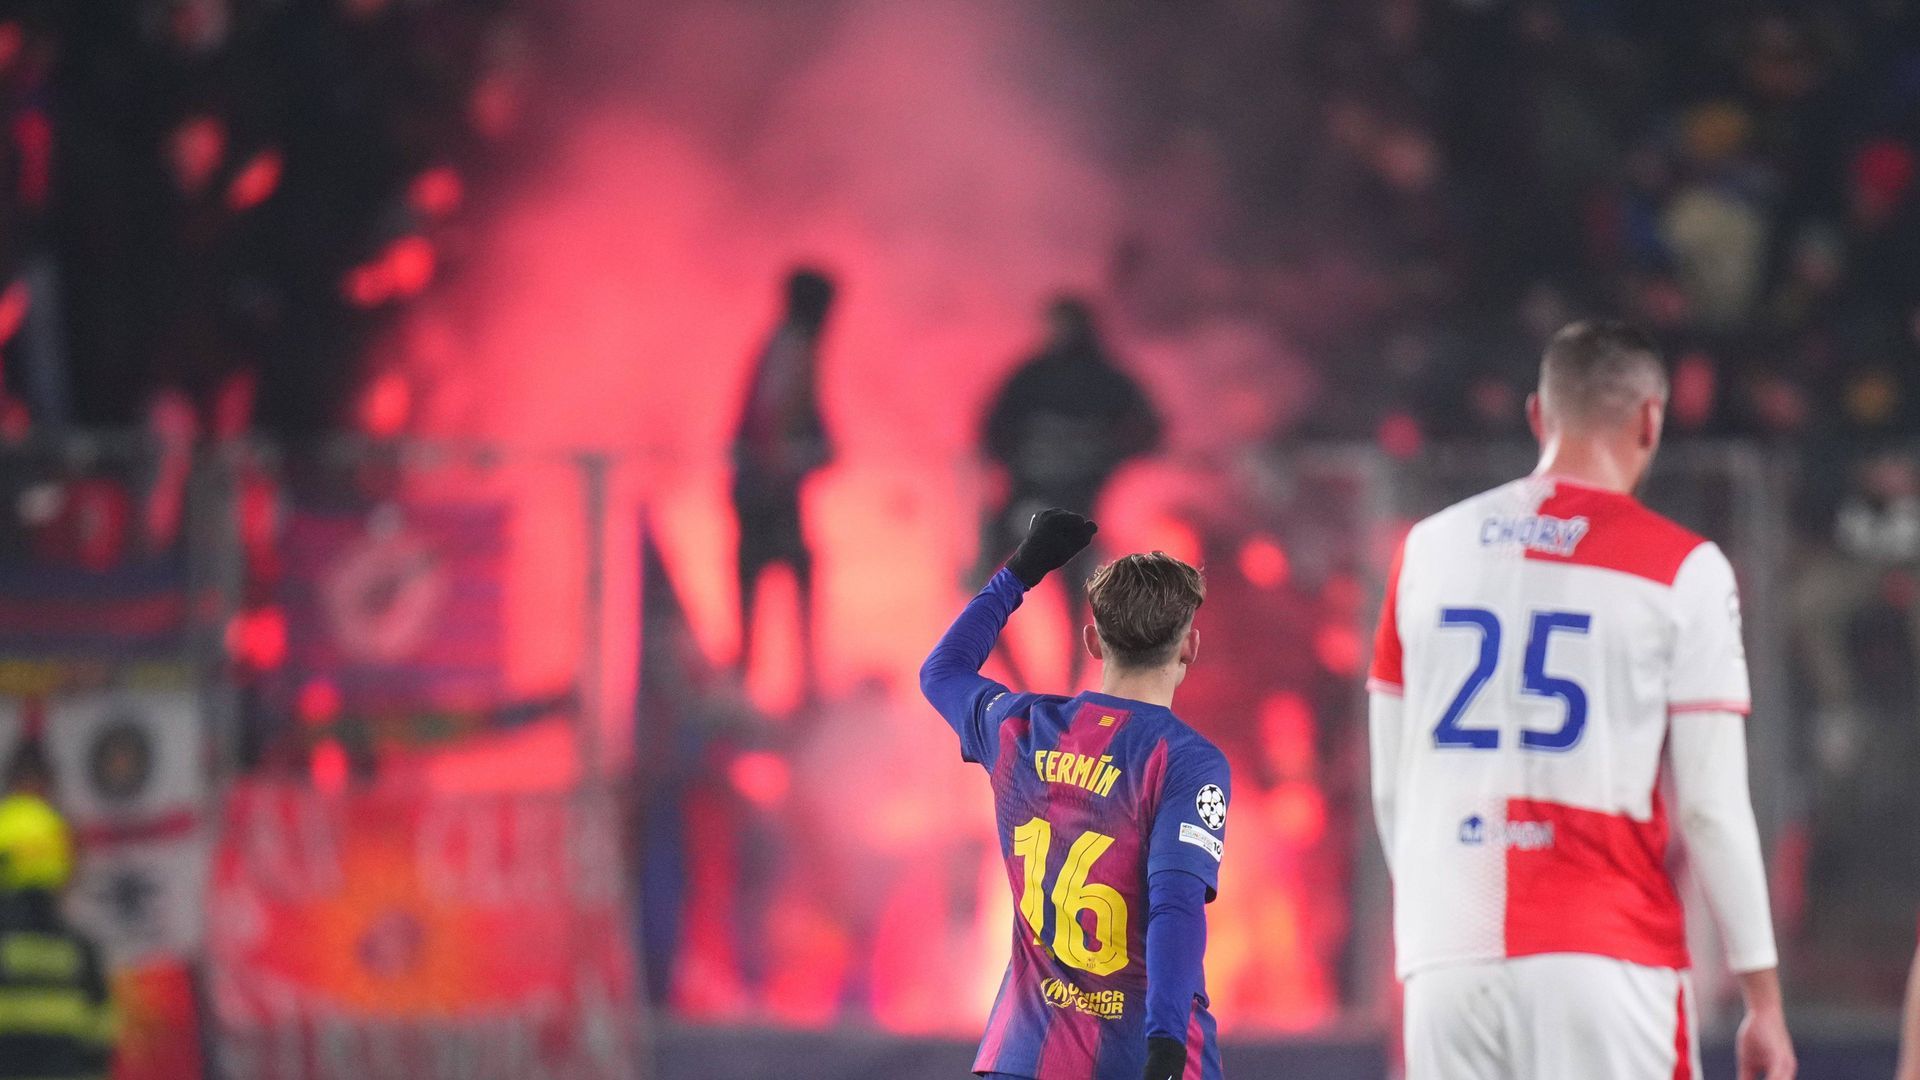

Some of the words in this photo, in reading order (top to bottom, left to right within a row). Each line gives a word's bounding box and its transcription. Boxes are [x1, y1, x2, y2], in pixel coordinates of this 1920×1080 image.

[1433, 607, 1592, 752] 25
[1035, 750, 1122, 797] FERMÍN
[1014, 816, 1130, 976] 16
